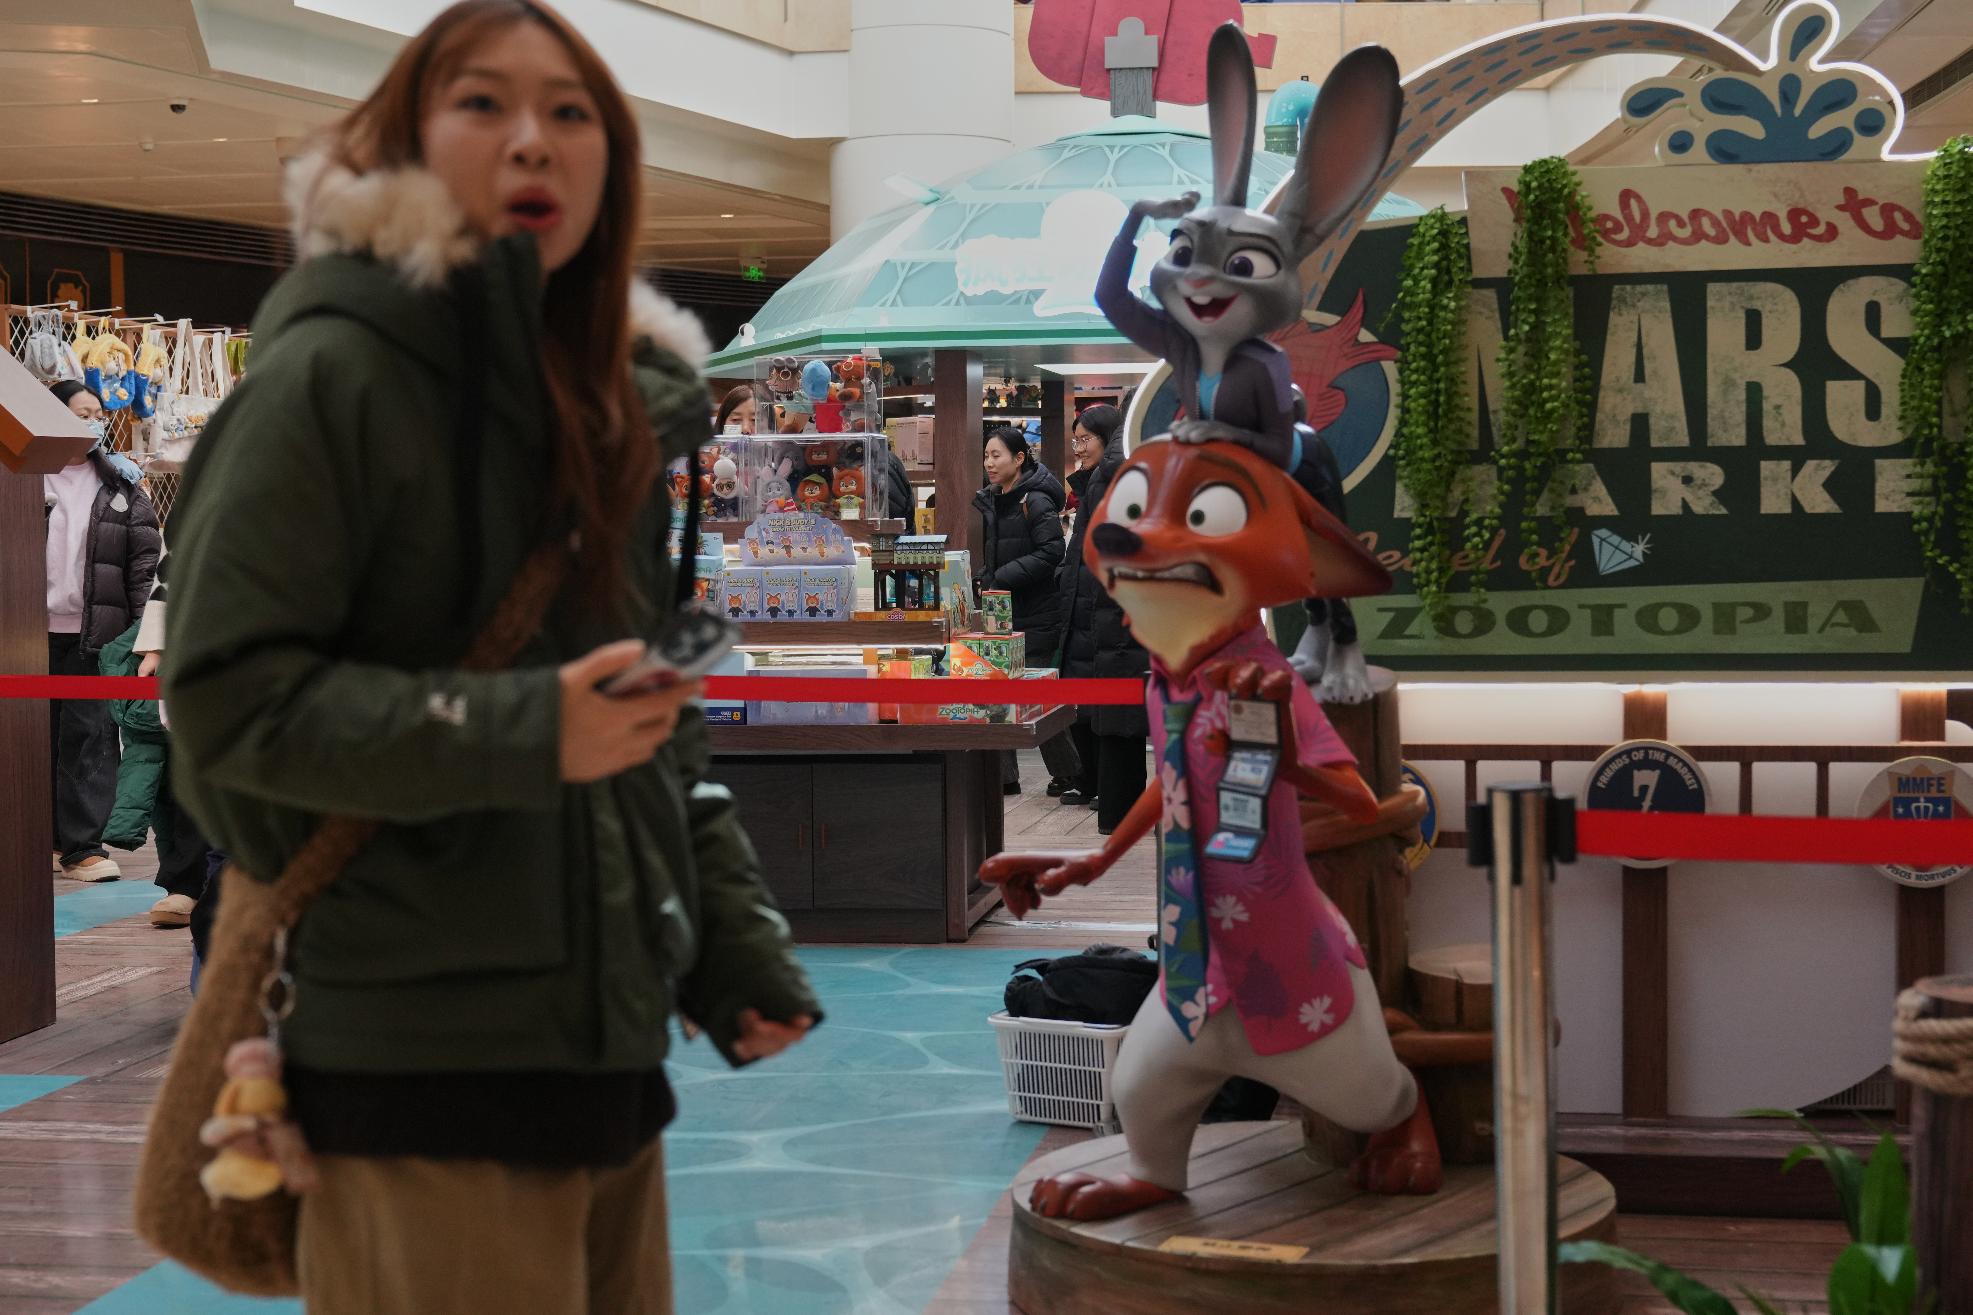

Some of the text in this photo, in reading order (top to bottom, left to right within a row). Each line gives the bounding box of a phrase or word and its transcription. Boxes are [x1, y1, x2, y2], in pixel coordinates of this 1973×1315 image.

[1836, 186, 1923, 242] to
[1518, 527, 1579, 588] of
[1377, 599, 1883, 640] ZOOTOPIA
[1597, 749, 1699, 790] FRIENDS OF THE MARKET
[1897, 776, 1946, 794] MMFE
